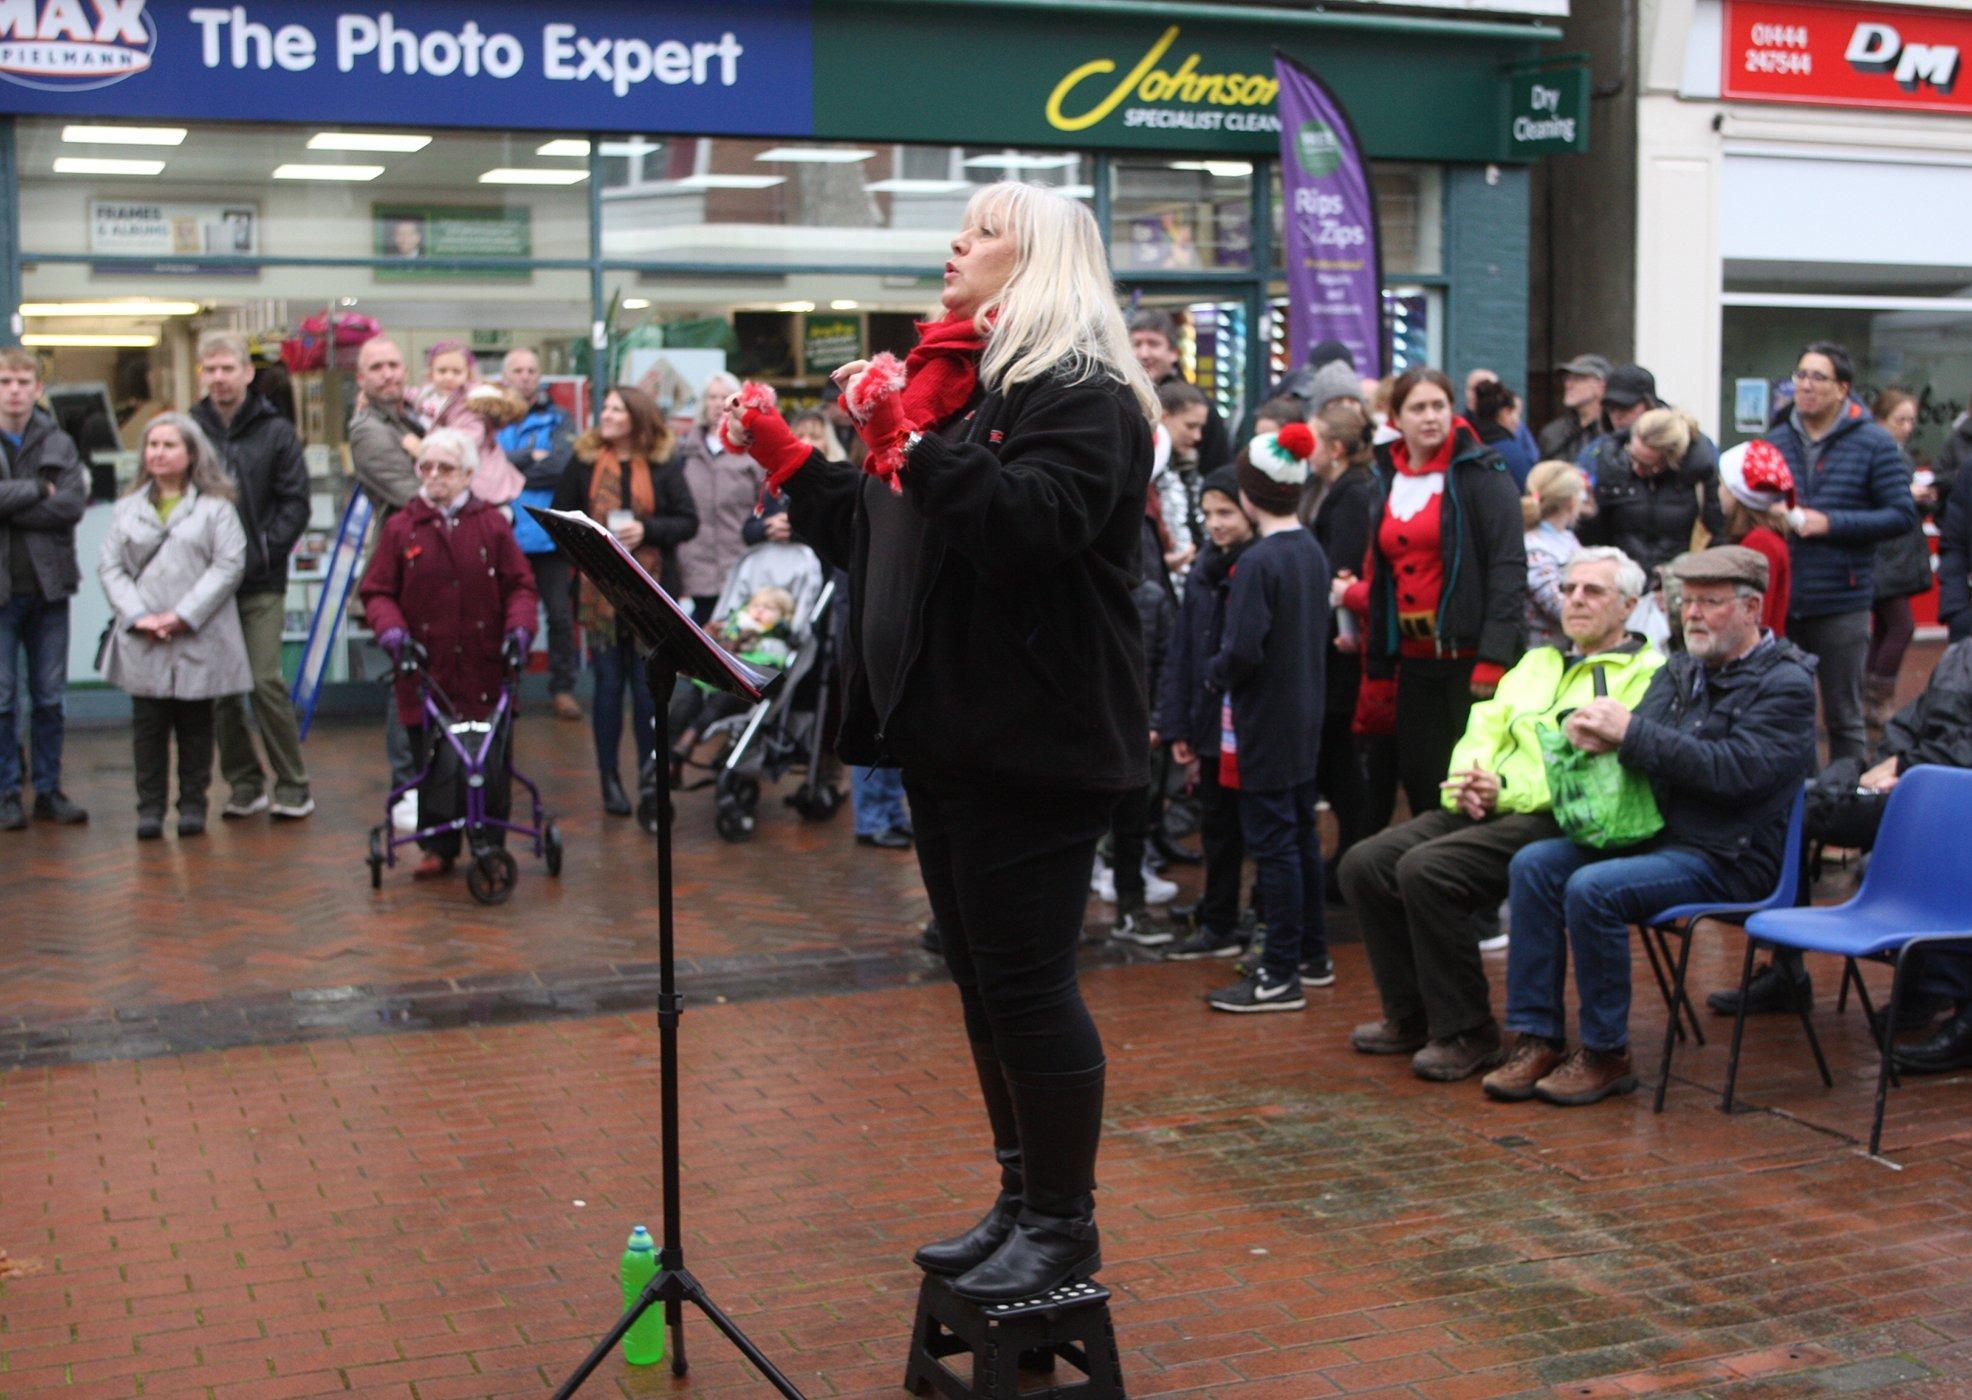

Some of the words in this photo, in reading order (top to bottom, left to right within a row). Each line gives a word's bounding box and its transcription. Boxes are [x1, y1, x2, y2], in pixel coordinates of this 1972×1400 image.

[188, 5, 316, 71] The
[336, 11, 524, 79] Photo
[543, 23, 744, 97] Expert
[1751, 22, 1808, 49] 01444
[1531, 84, 1561, 119] Dry
[1123, 108, 1224, 130] SPECIALIST
[1513, 116, 1575, 142] Cleaning
[1294, 186, 1343, 219] Rips
[1319, 219, 1365, 250] Zips
